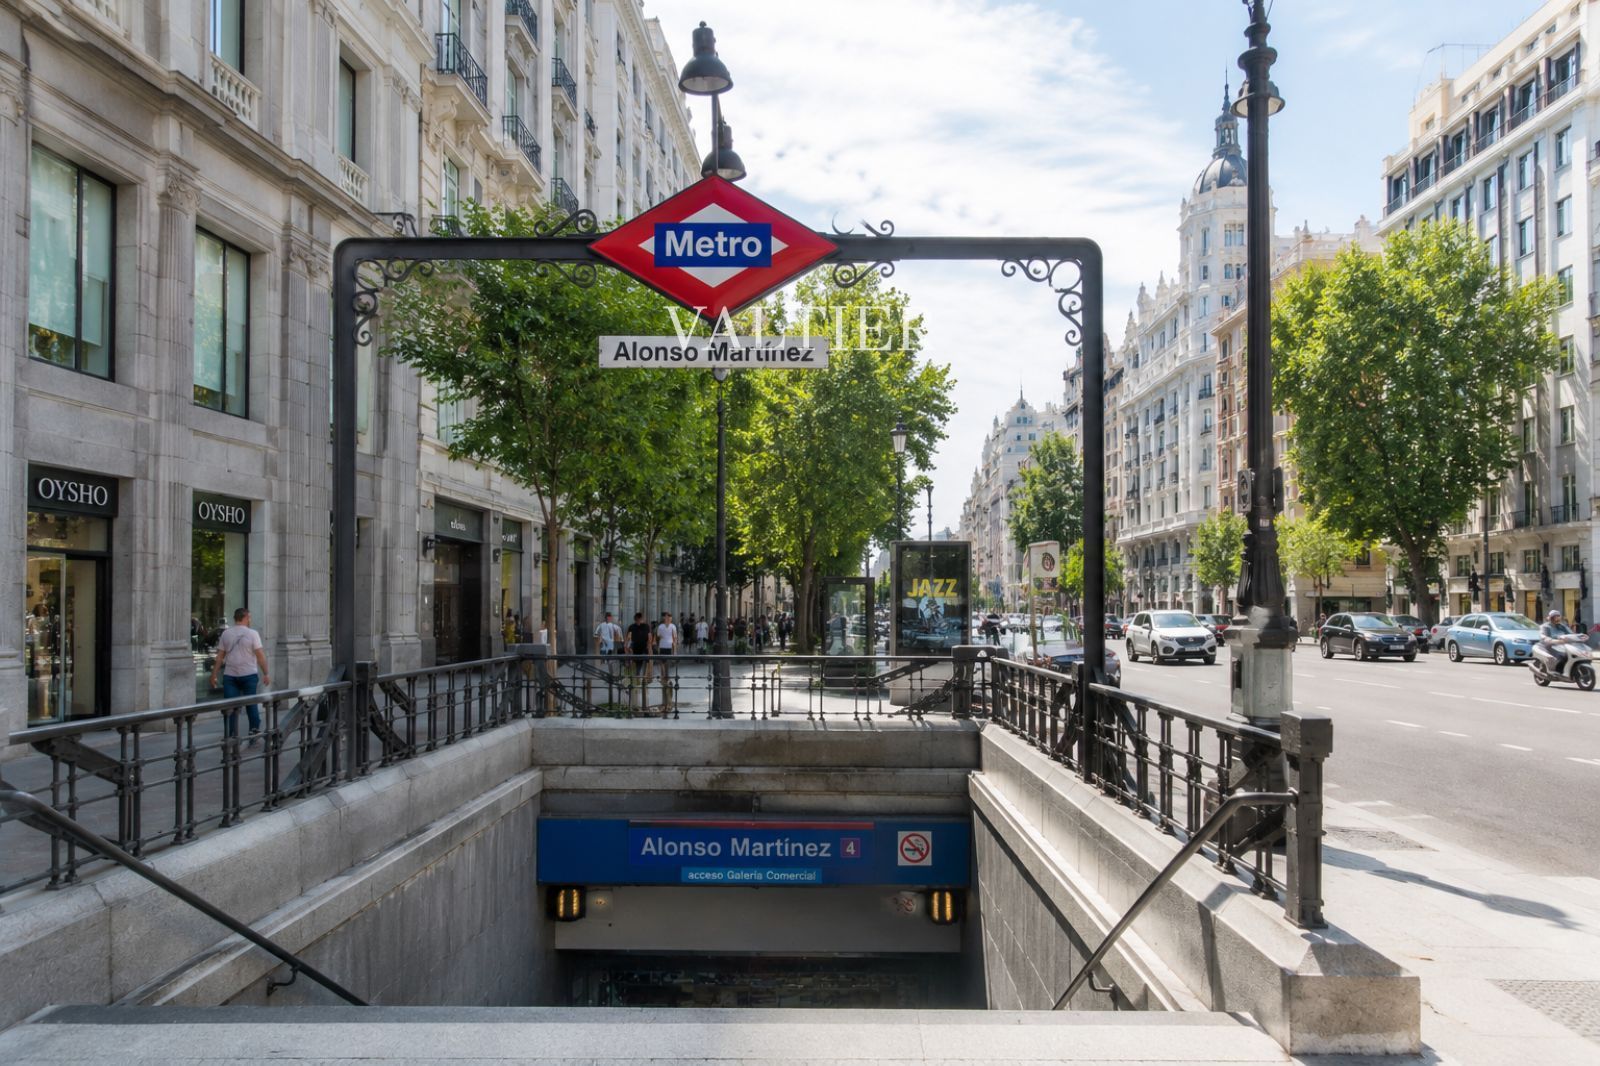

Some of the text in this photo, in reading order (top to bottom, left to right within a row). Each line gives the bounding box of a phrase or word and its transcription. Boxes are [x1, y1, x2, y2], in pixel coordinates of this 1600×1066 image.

[665, 230, 763, 257] Metro
[613, 341, 815, 362] Alonso Martínez
[38, 477, 108, 506] OYSHO
[198, 501, 245, 525] OYSHO
[907, 578, 958, 598] JAZZ
[641, 837, 855, 857] Alonso Martínez 4
[688, 872, 724, 880] acceso
[766, 870, 816, 881] Comercial
